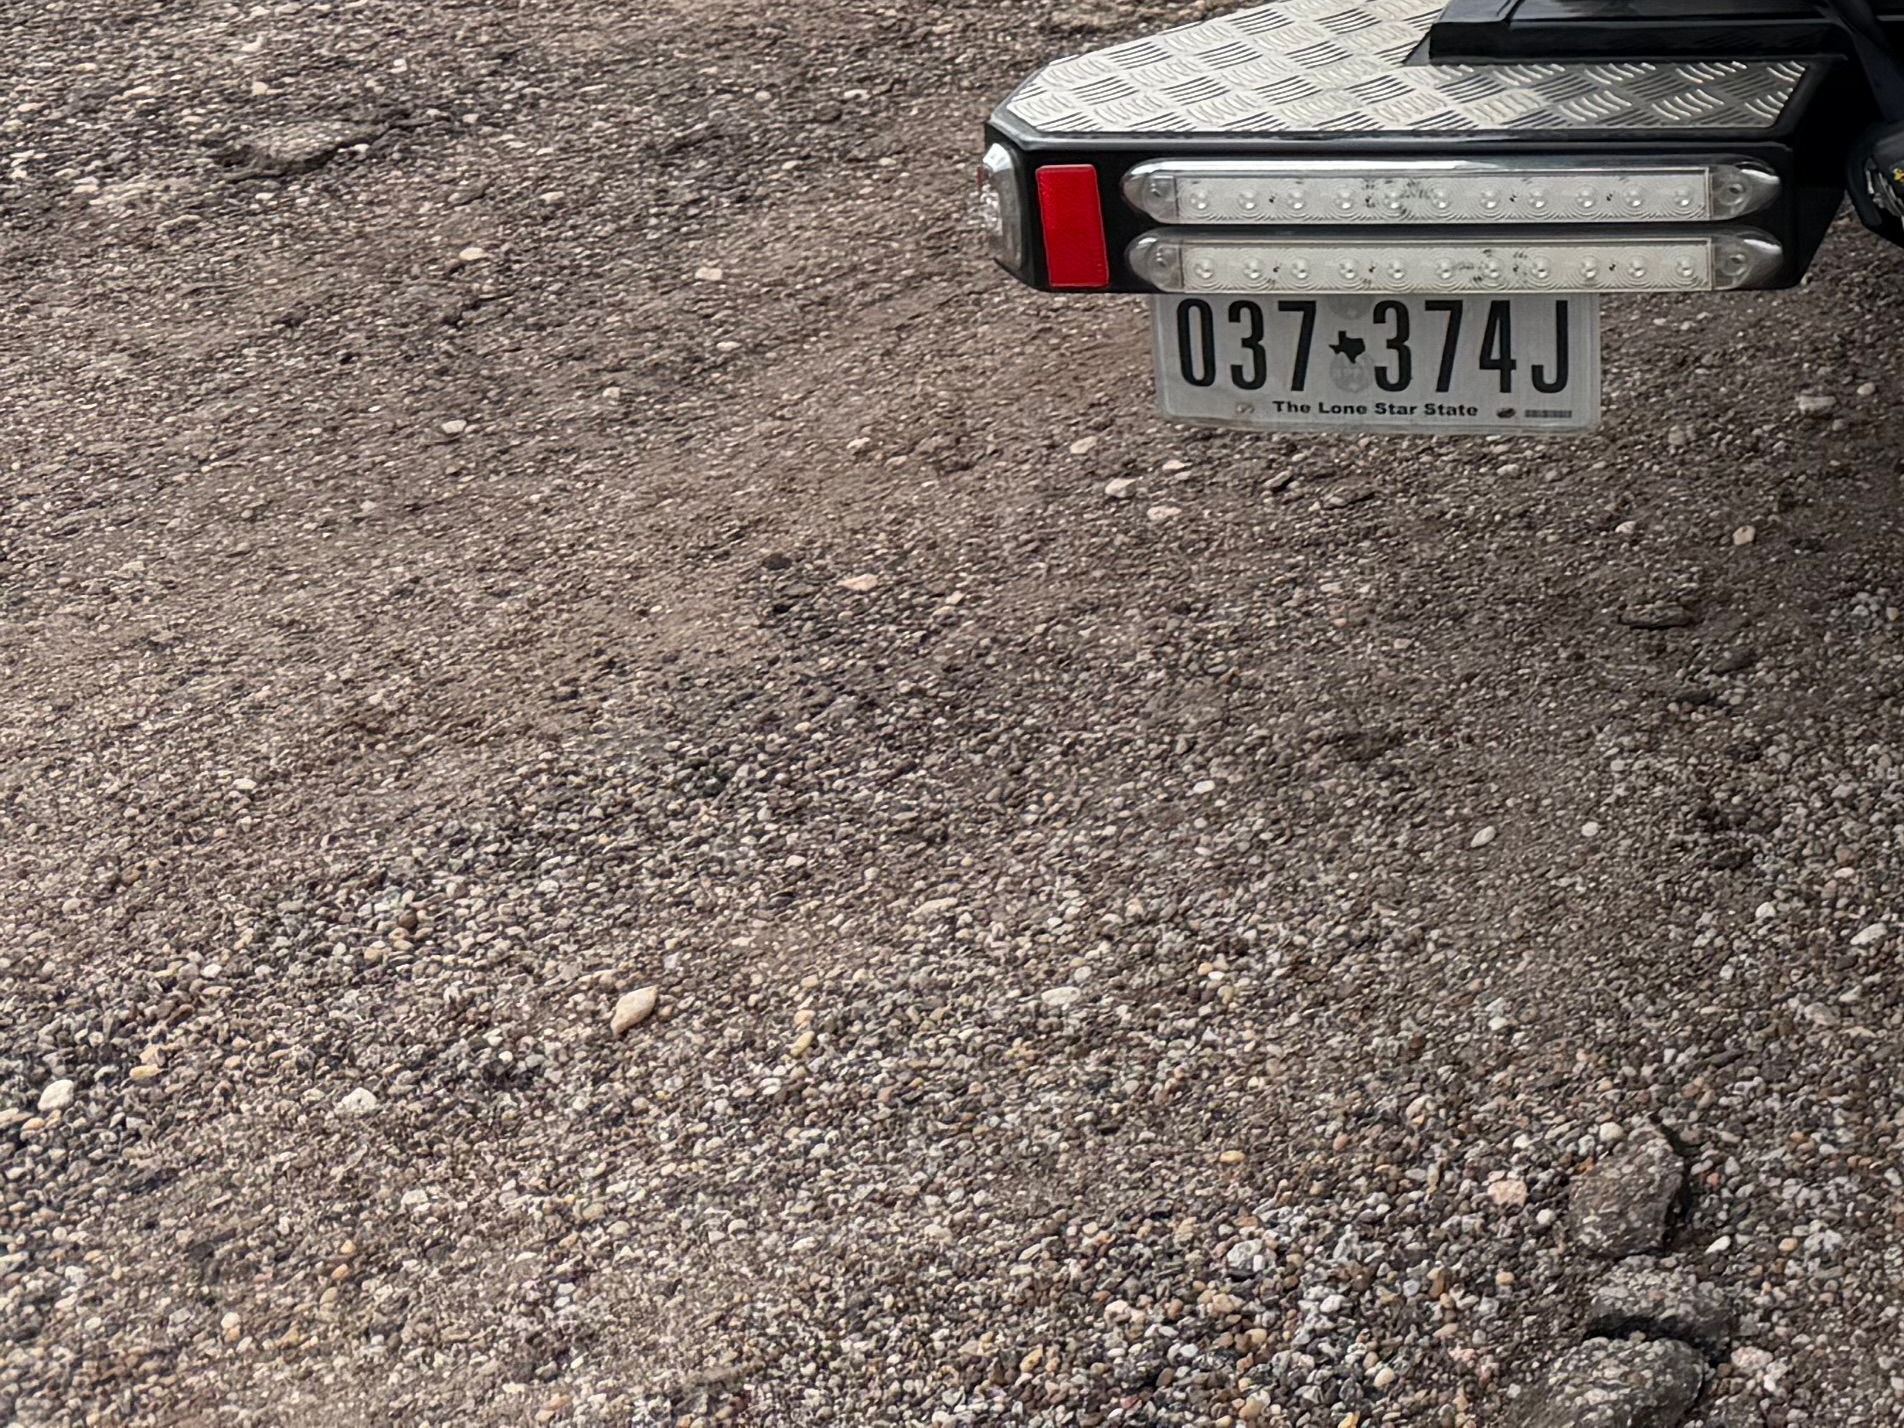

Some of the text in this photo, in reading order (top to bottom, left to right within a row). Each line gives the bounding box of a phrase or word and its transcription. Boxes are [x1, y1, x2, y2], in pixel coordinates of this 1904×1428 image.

[1175, 297, 1570, 394] 037 374J
[1273, 400, 1479, 417] The Lone Star State
